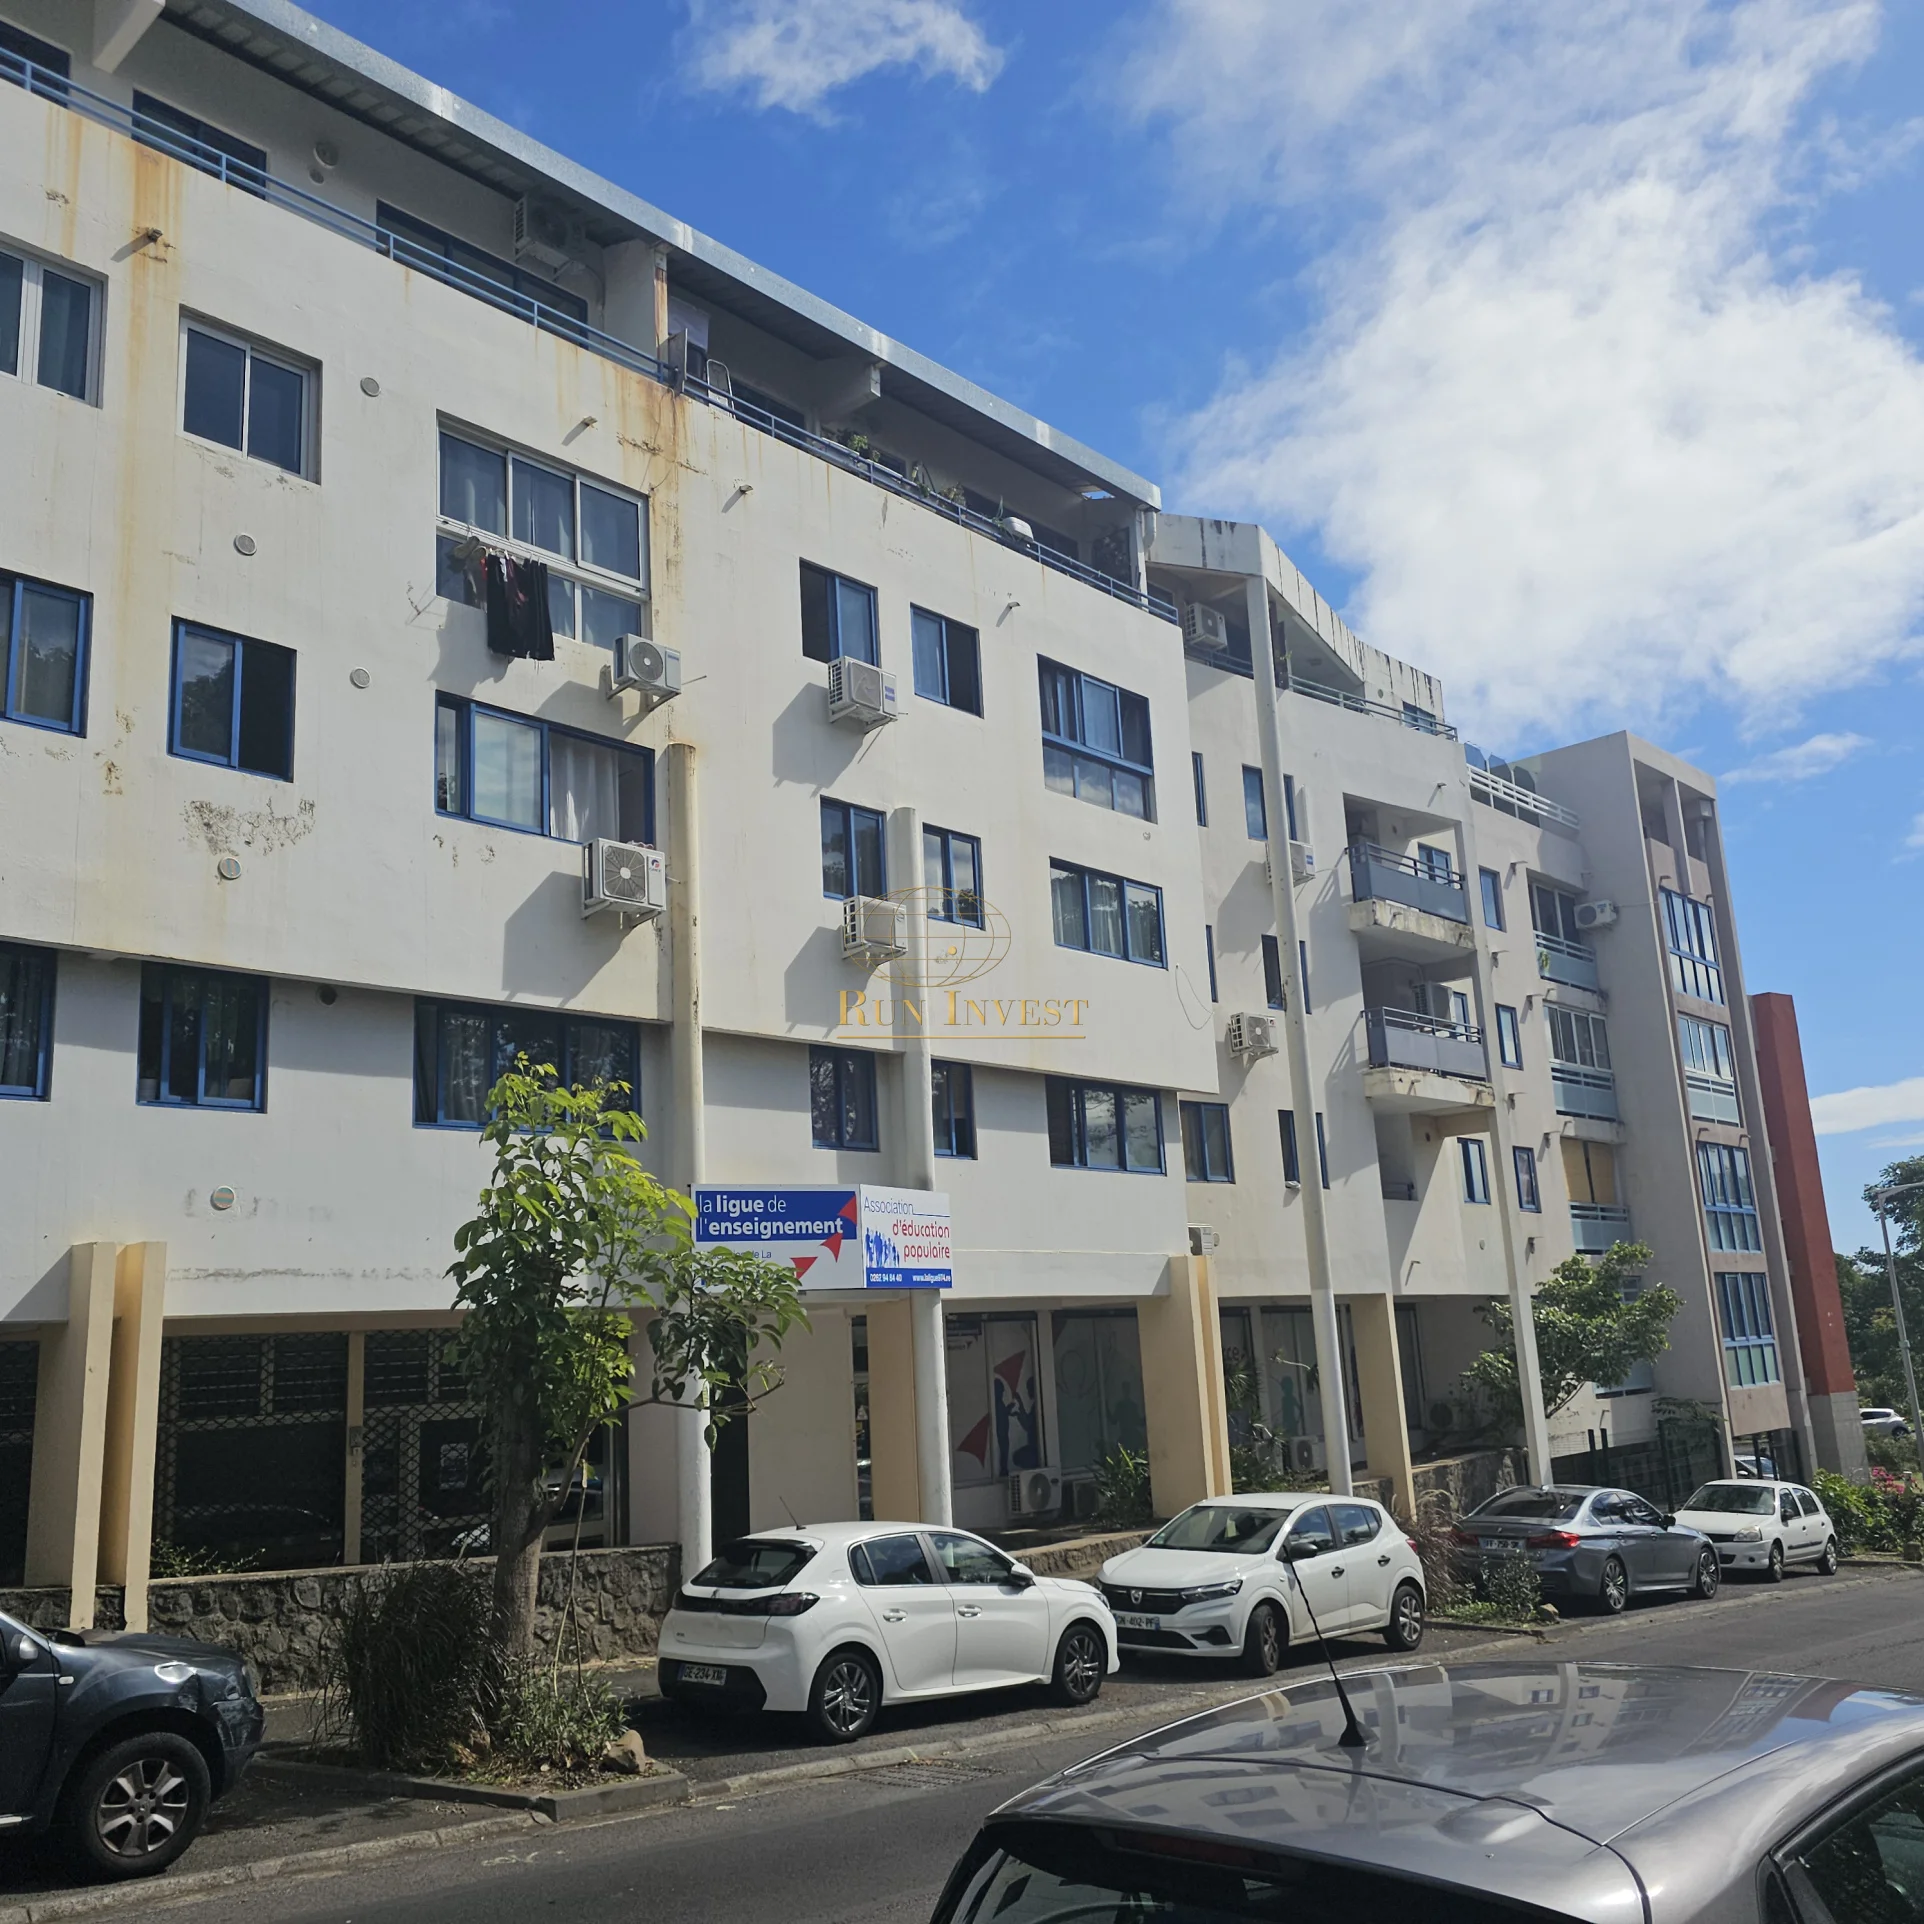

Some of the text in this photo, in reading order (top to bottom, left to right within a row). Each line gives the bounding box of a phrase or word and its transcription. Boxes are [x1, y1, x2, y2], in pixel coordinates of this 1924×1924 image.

[699, 1194, 787, 1218] la ligue de
[863, 1196, 914, 1216] Association
[699, 1217, 843, 1239] l'enseignement
[892, 1219, 950, 1239] d'éducation
[761, 1249, 772, 1259] La
[904, 1241, 950, 1263] populaire
